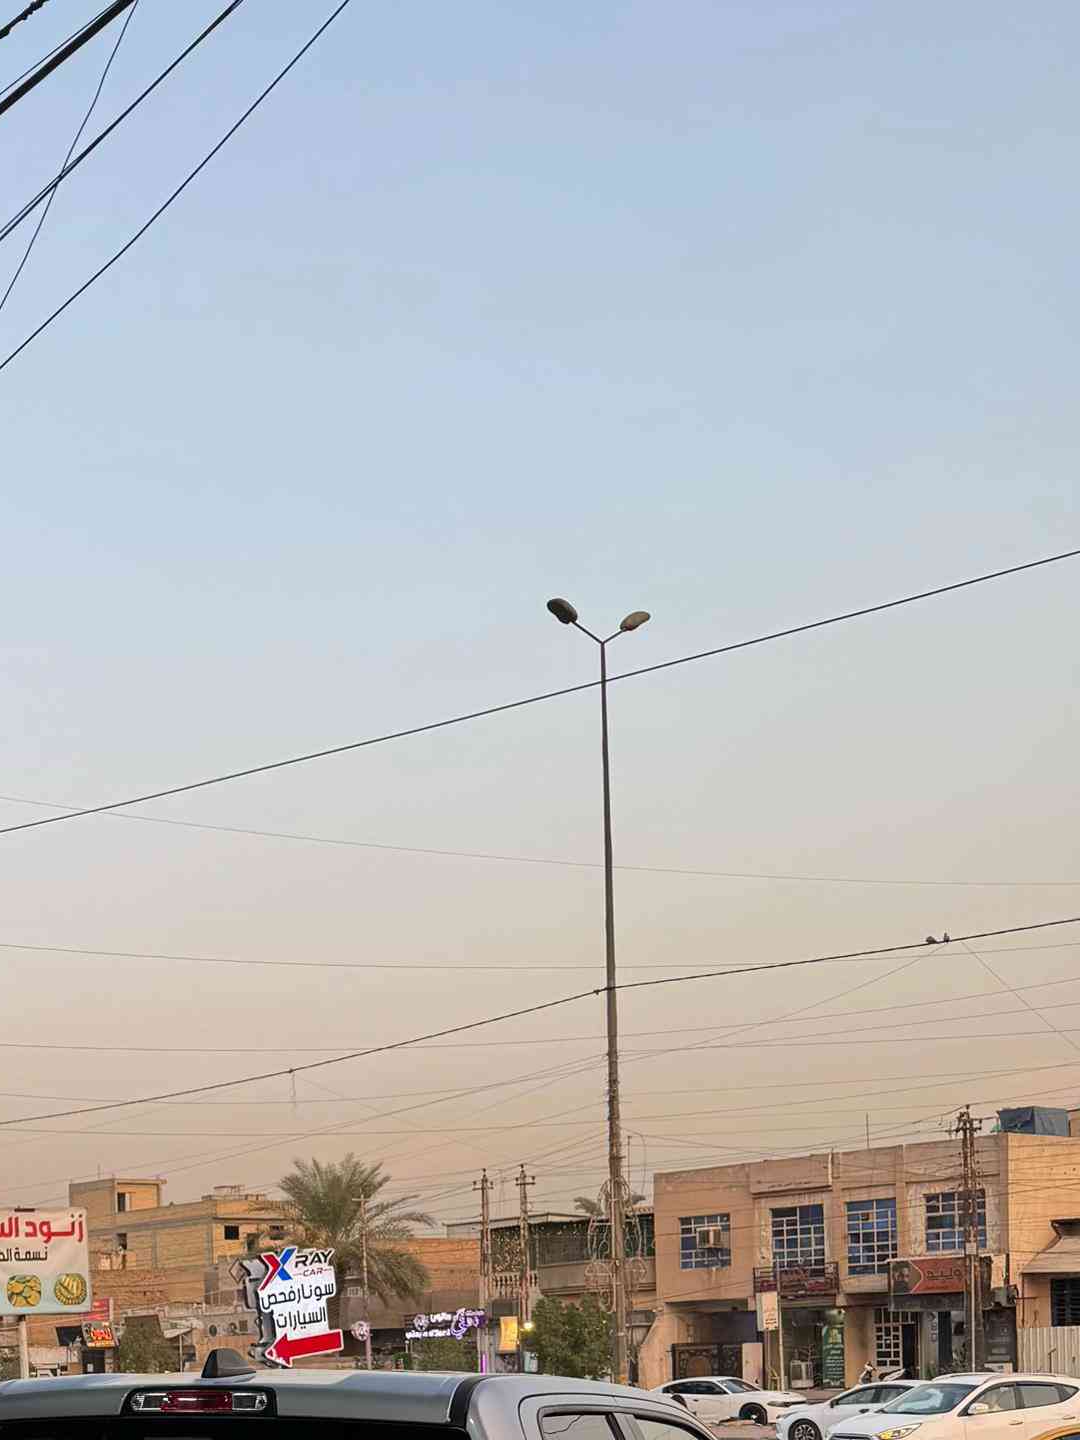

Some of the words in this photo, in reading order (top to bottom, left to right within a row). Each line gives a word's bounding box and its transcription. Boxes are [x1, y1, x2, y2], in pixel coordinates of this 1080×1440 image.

[24, 1213, 84, 1244] زنود
[14, 1245, 49, 1262] نسمة
[303, 1267, 323, 1277] CAR
[276, 1306, 327, 1331] السيارات
